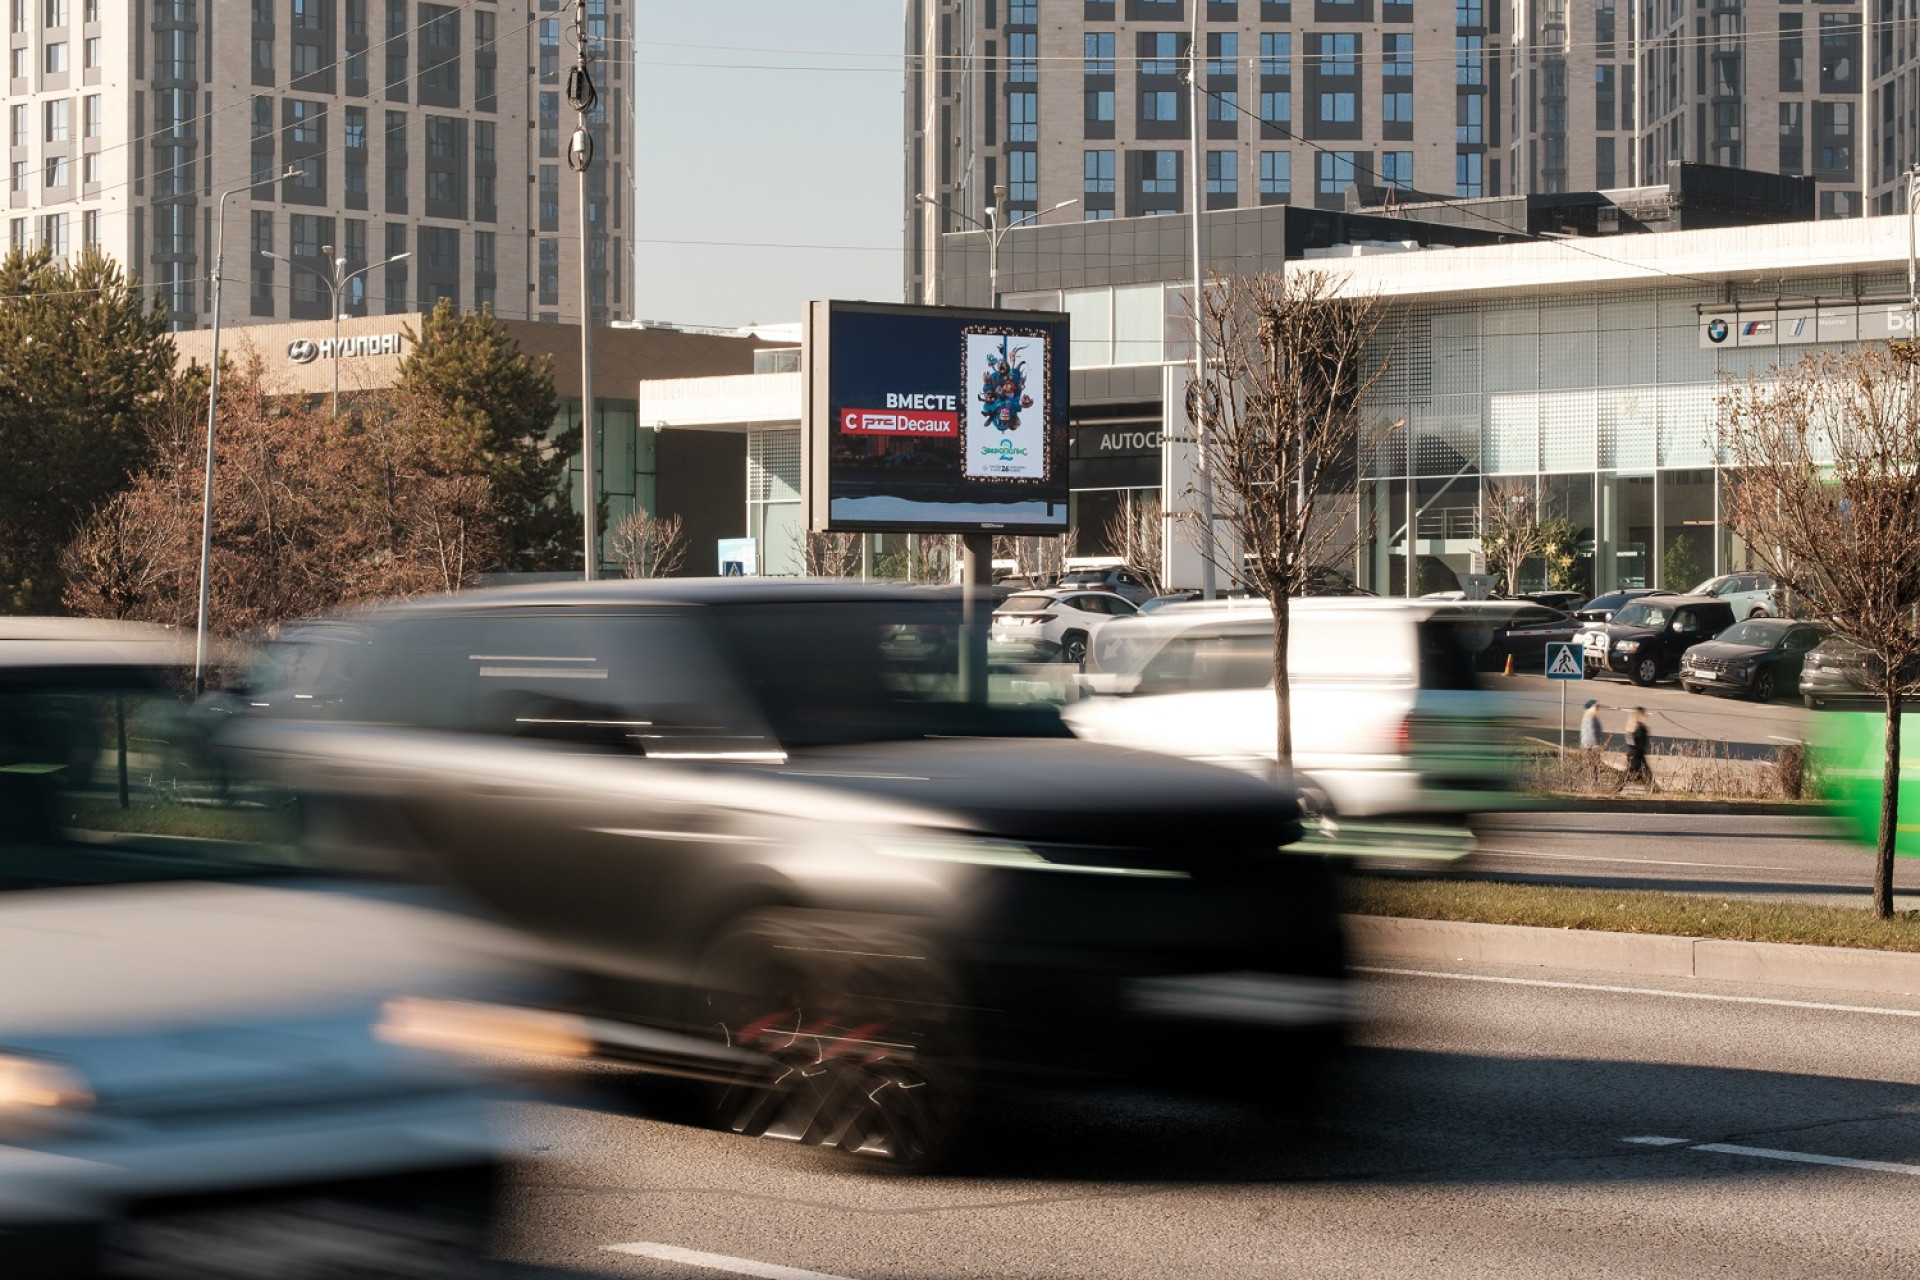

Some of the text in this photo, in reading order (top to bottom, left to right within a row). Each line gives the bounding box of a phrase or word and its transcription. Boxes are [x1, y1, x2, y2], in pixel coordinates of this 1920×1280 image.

[1887, 306, 1920, 330] Ба
[320, 334, 400, 358] HYUNDAI
[886, 392, 957, 410] ВМЕСТЕ
[845, 413, 858, 429] С
[1100, 432, 1164, 450] AUTOCE
